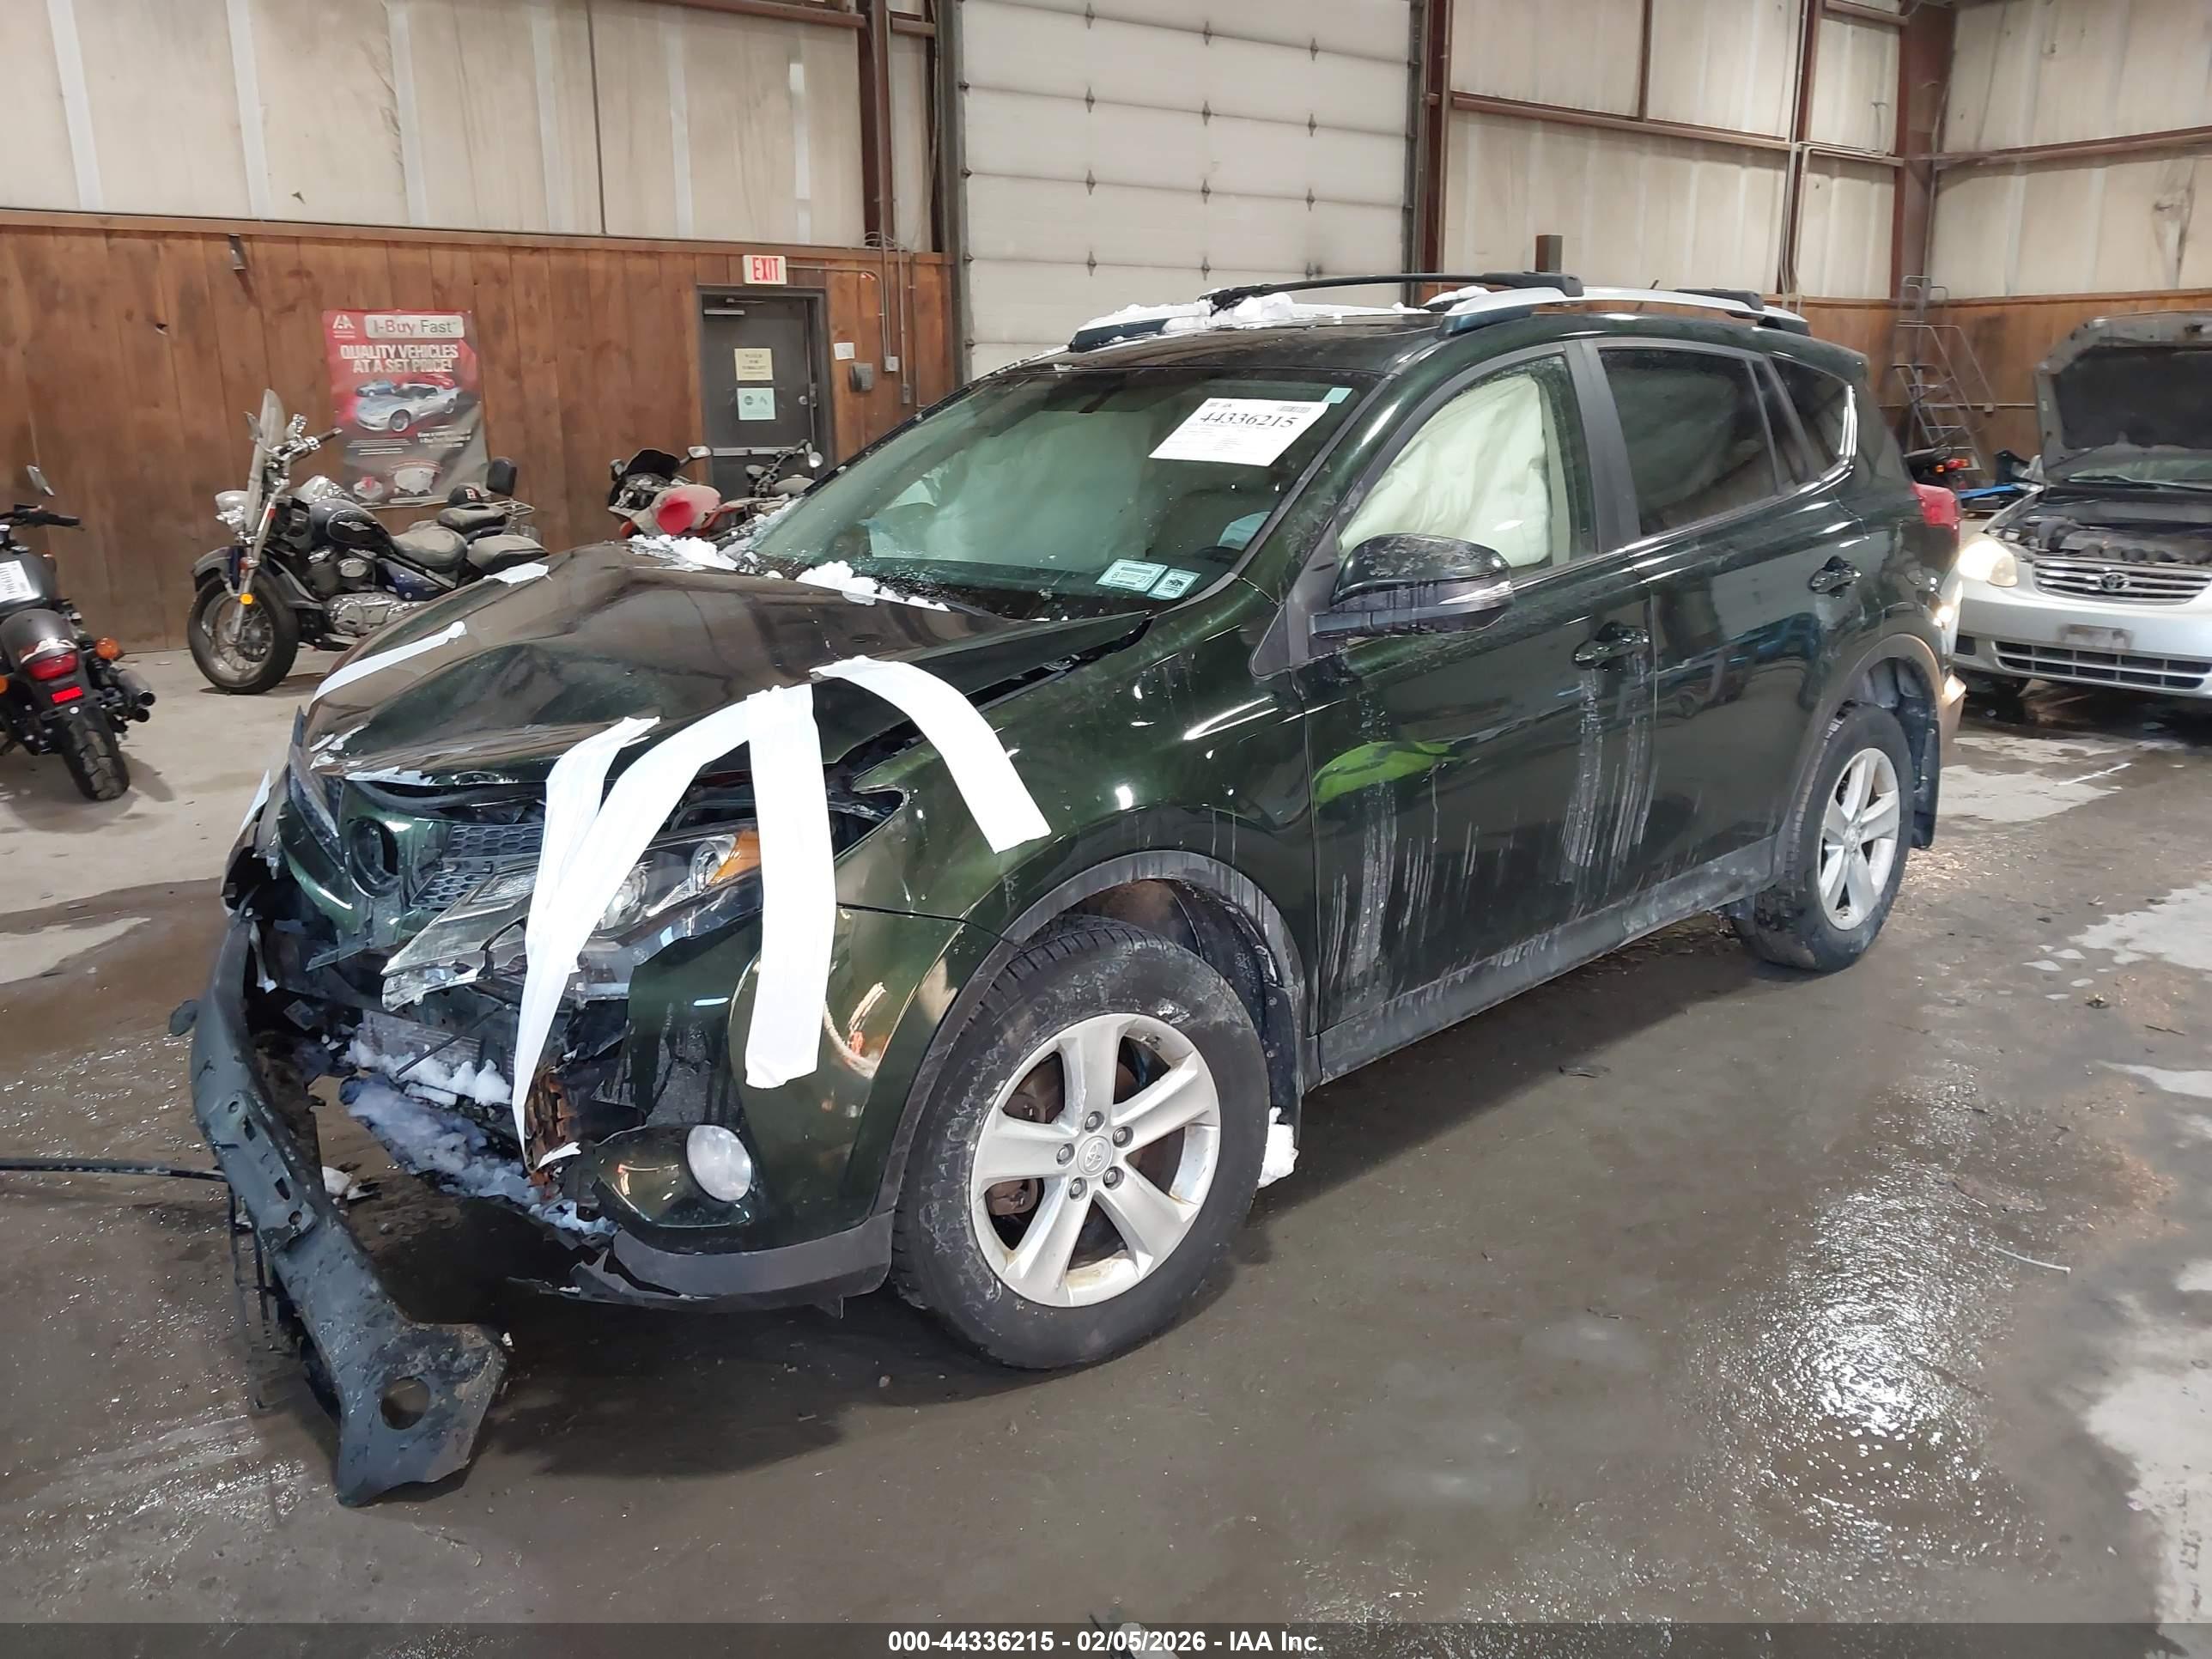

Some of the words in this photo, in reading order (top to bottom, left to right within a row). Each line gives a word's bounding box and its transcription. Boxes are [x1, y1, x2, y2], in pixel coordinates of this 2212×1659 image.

[753, 257, 779, 281] EXIT
[374, 319, 416, 335] I-Buy
[421, 319, 453, 333] Fast
[340, 344, 397, 359] QUALITY
[398, 344, 459, 359] VEHICLES
[353, 360, 371, 373] AT
[373, 360, 384, 373] A
[386, 360, 410, 373] SET
[412, 359, 453, 373] PRICE!
[1200, 411, 1299, 428] 44336215
